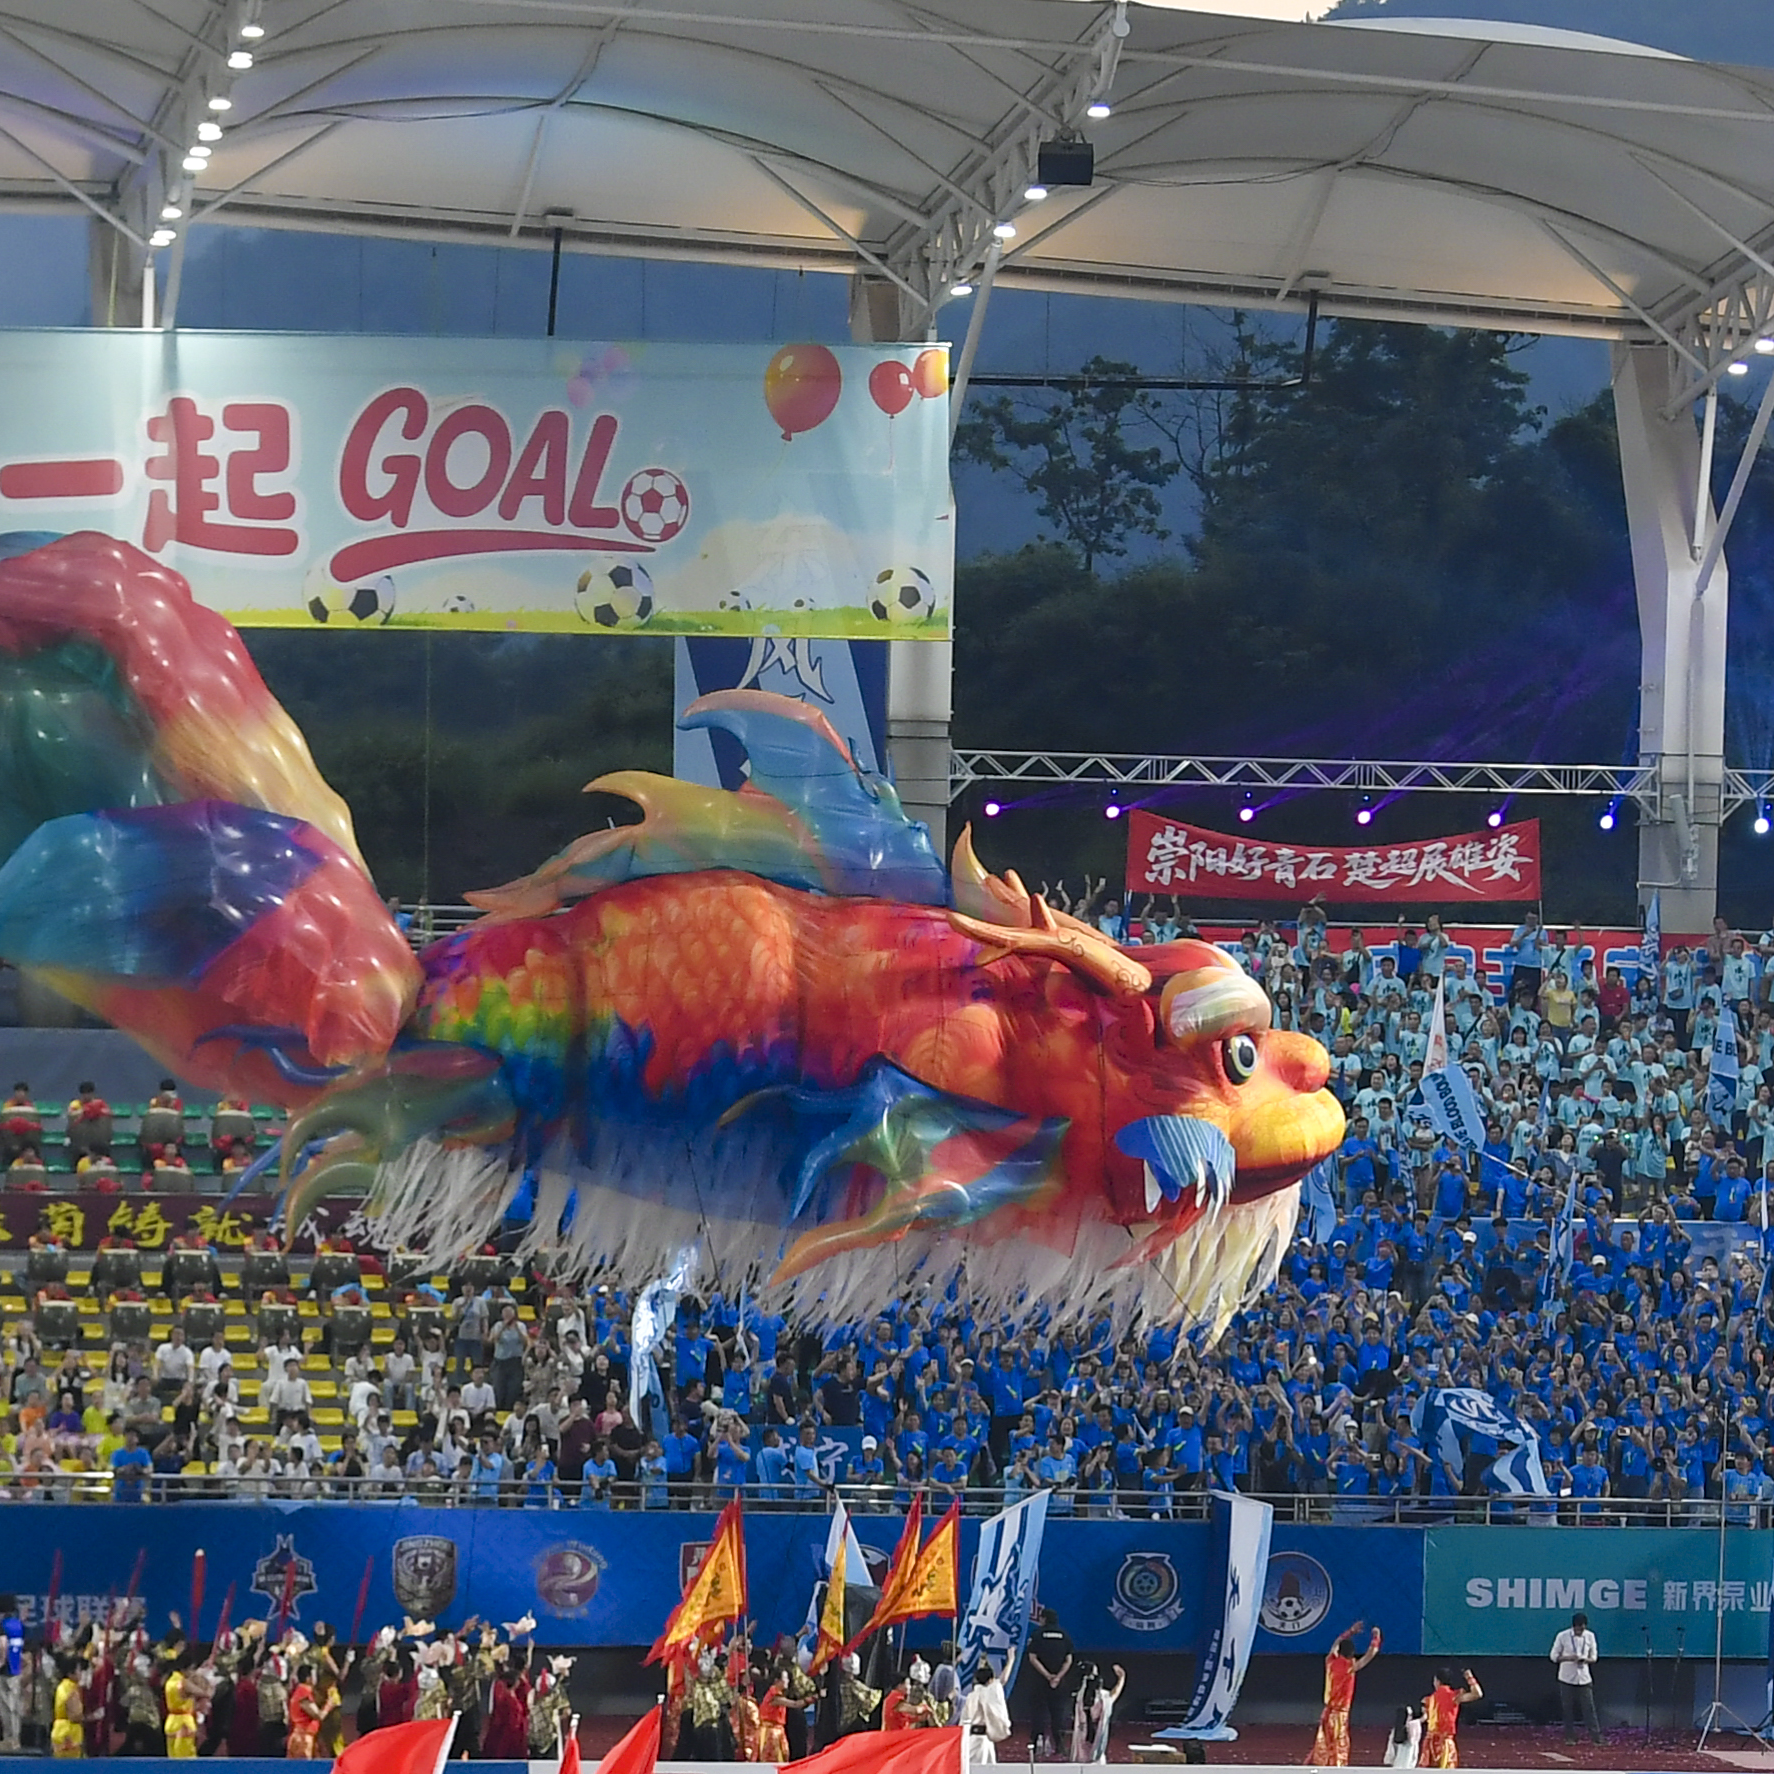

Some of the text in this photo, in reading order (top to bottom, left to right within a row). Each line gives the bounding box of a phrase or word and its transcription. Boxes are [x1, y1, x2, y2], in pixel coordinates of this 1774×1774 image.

[339, 386, 624, 528] GOAL
[1342, 831, 1534, 895] 楚超展雄姿
[1465, 1577, 1774, 1613] SHIMGE 新界泵业
